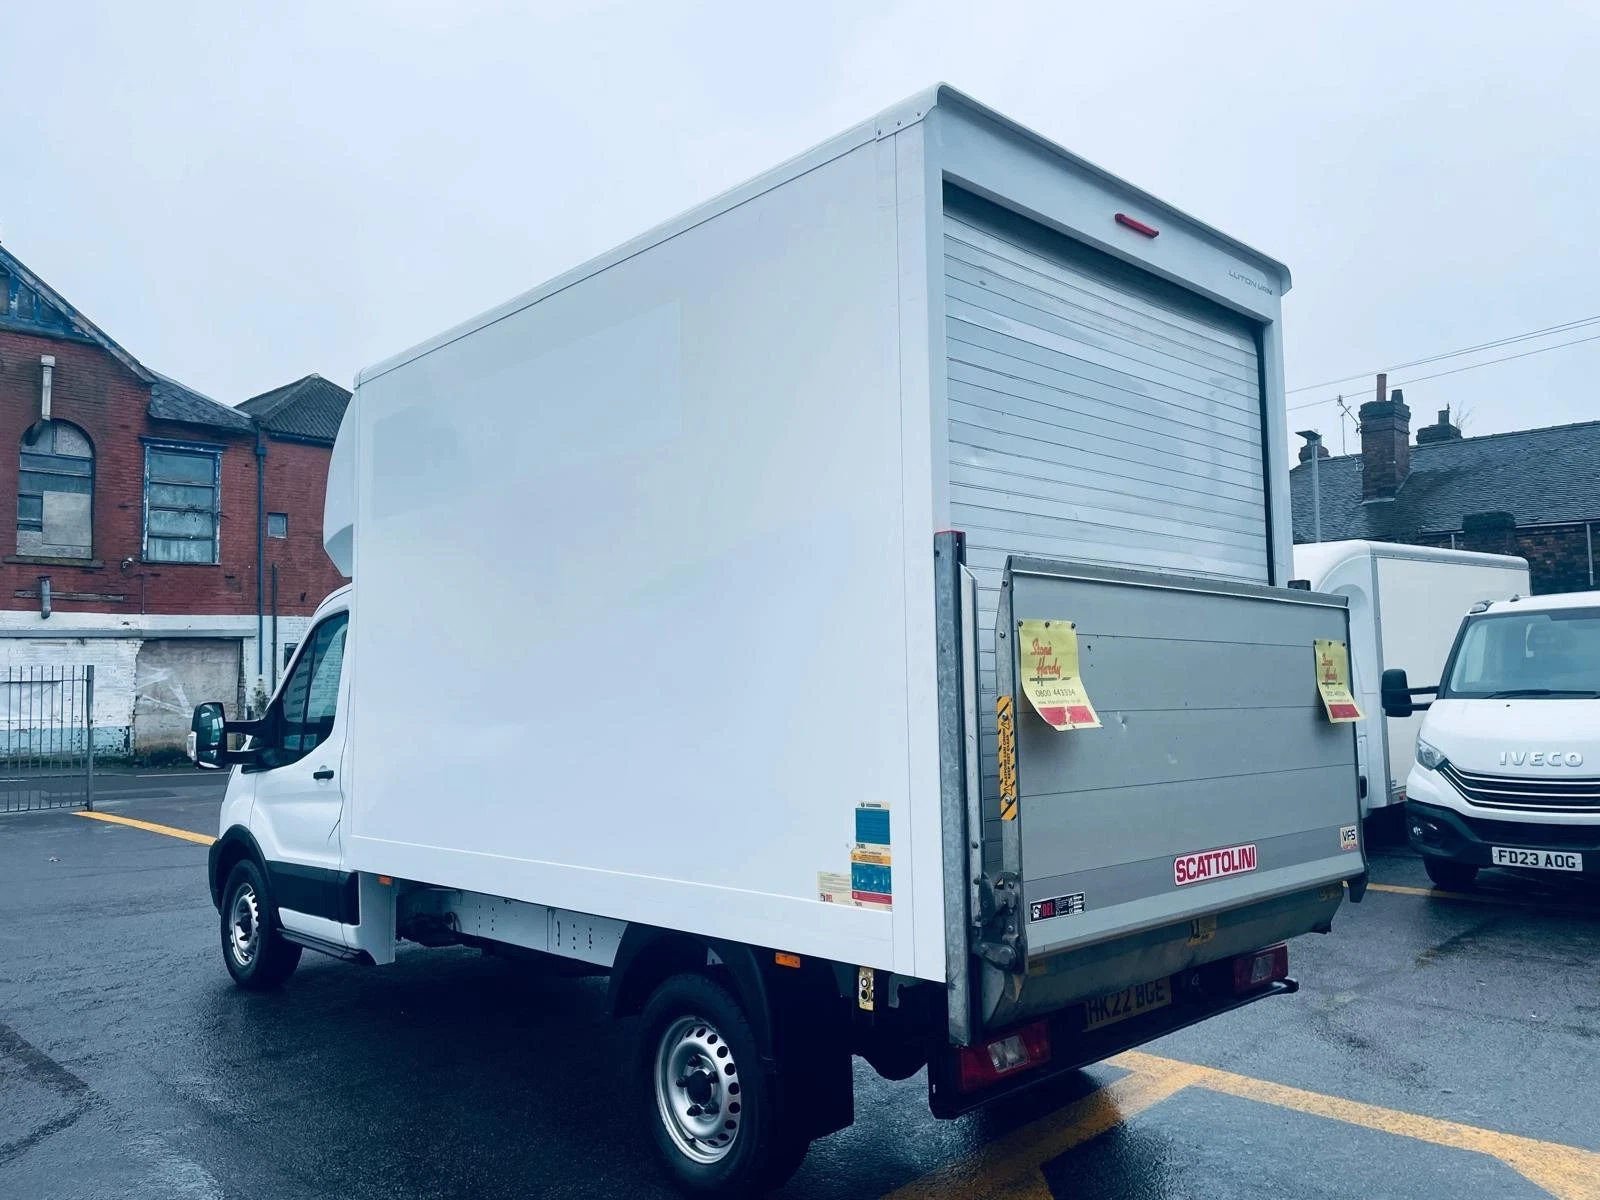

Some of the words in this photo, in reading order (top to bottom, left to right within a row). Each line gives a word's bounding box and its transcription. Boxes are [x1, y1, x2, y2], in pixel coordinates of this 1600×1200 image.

[1228, 269, 1257, 289] LUTON
[1035, 656, 1062, 680] Hardy
[1499, 751, 1584, 768] IVECO
[1342, 829, 1356, 842] VFS
[1175, 846, 1256, 883] SCATTOLINI
[1498, 849, 1539, 865] FD23
[1544, 853, 1577, 869] AOG
[1086, 986, 1132, 1025] HK22
